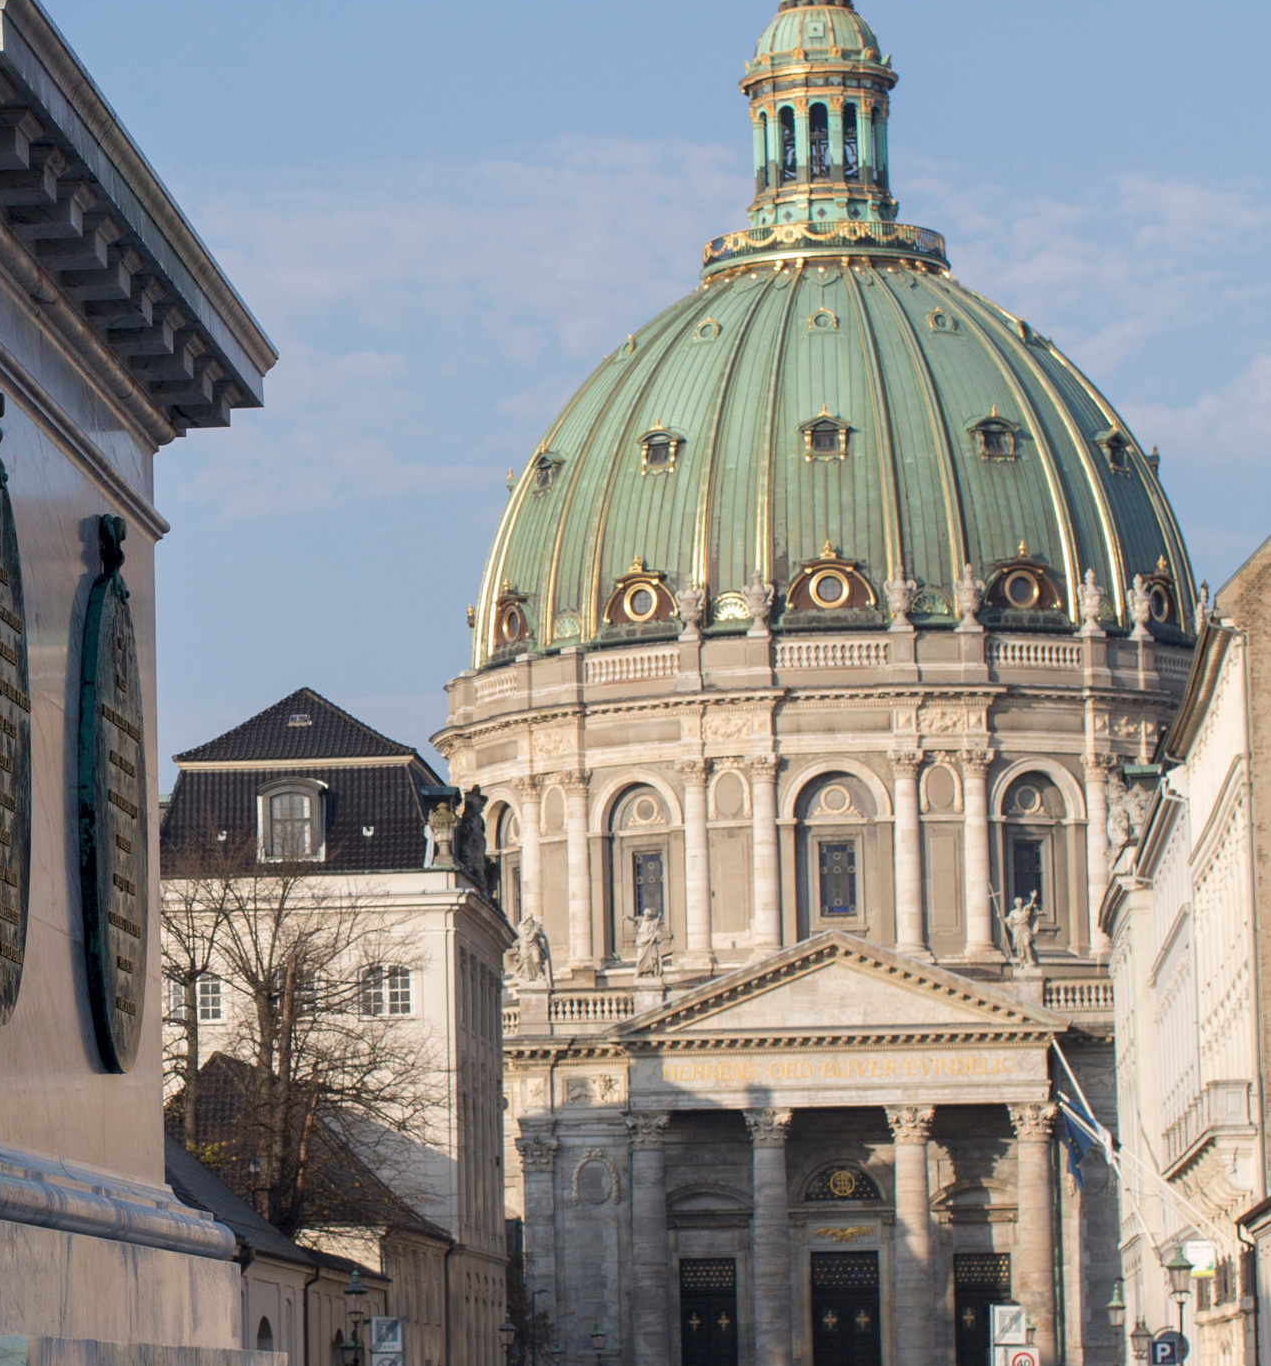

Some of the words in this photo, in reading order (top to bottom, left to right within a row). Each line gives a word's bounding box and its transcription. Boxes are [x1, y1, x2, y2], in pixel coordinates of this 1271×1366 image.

[662, 1062, 759, 1082] HERRENS
[768, 1061, 812, 1080] ORD
[821, 1058, 897, 1078] BLIVER
[1156, 1342, 1172, 1364] P
